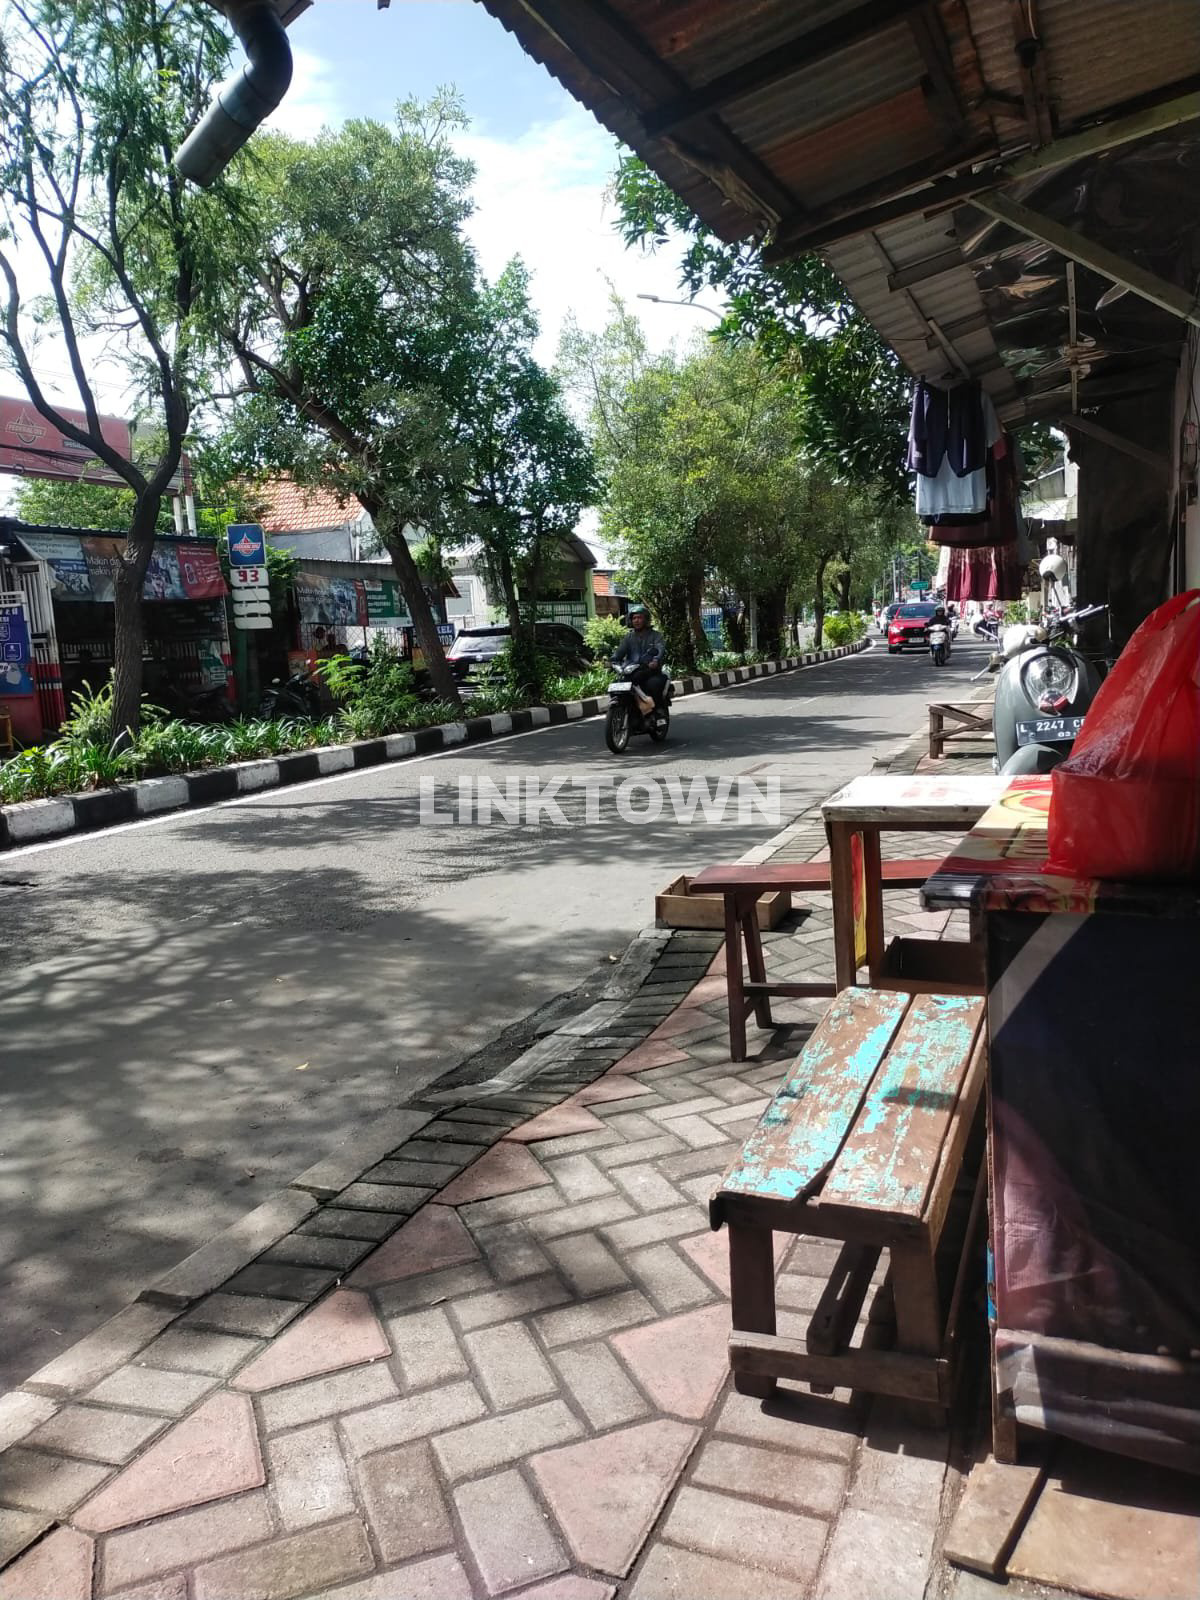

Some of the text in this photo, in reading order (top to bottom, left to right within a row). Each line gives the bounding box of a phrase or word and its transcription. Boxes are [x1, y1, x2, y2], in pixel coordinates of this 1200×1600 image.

[238, 569, 259, 583] 93
[1020, 724, 1028, 733] L
[1036, 720, 1065, 732] 2247
